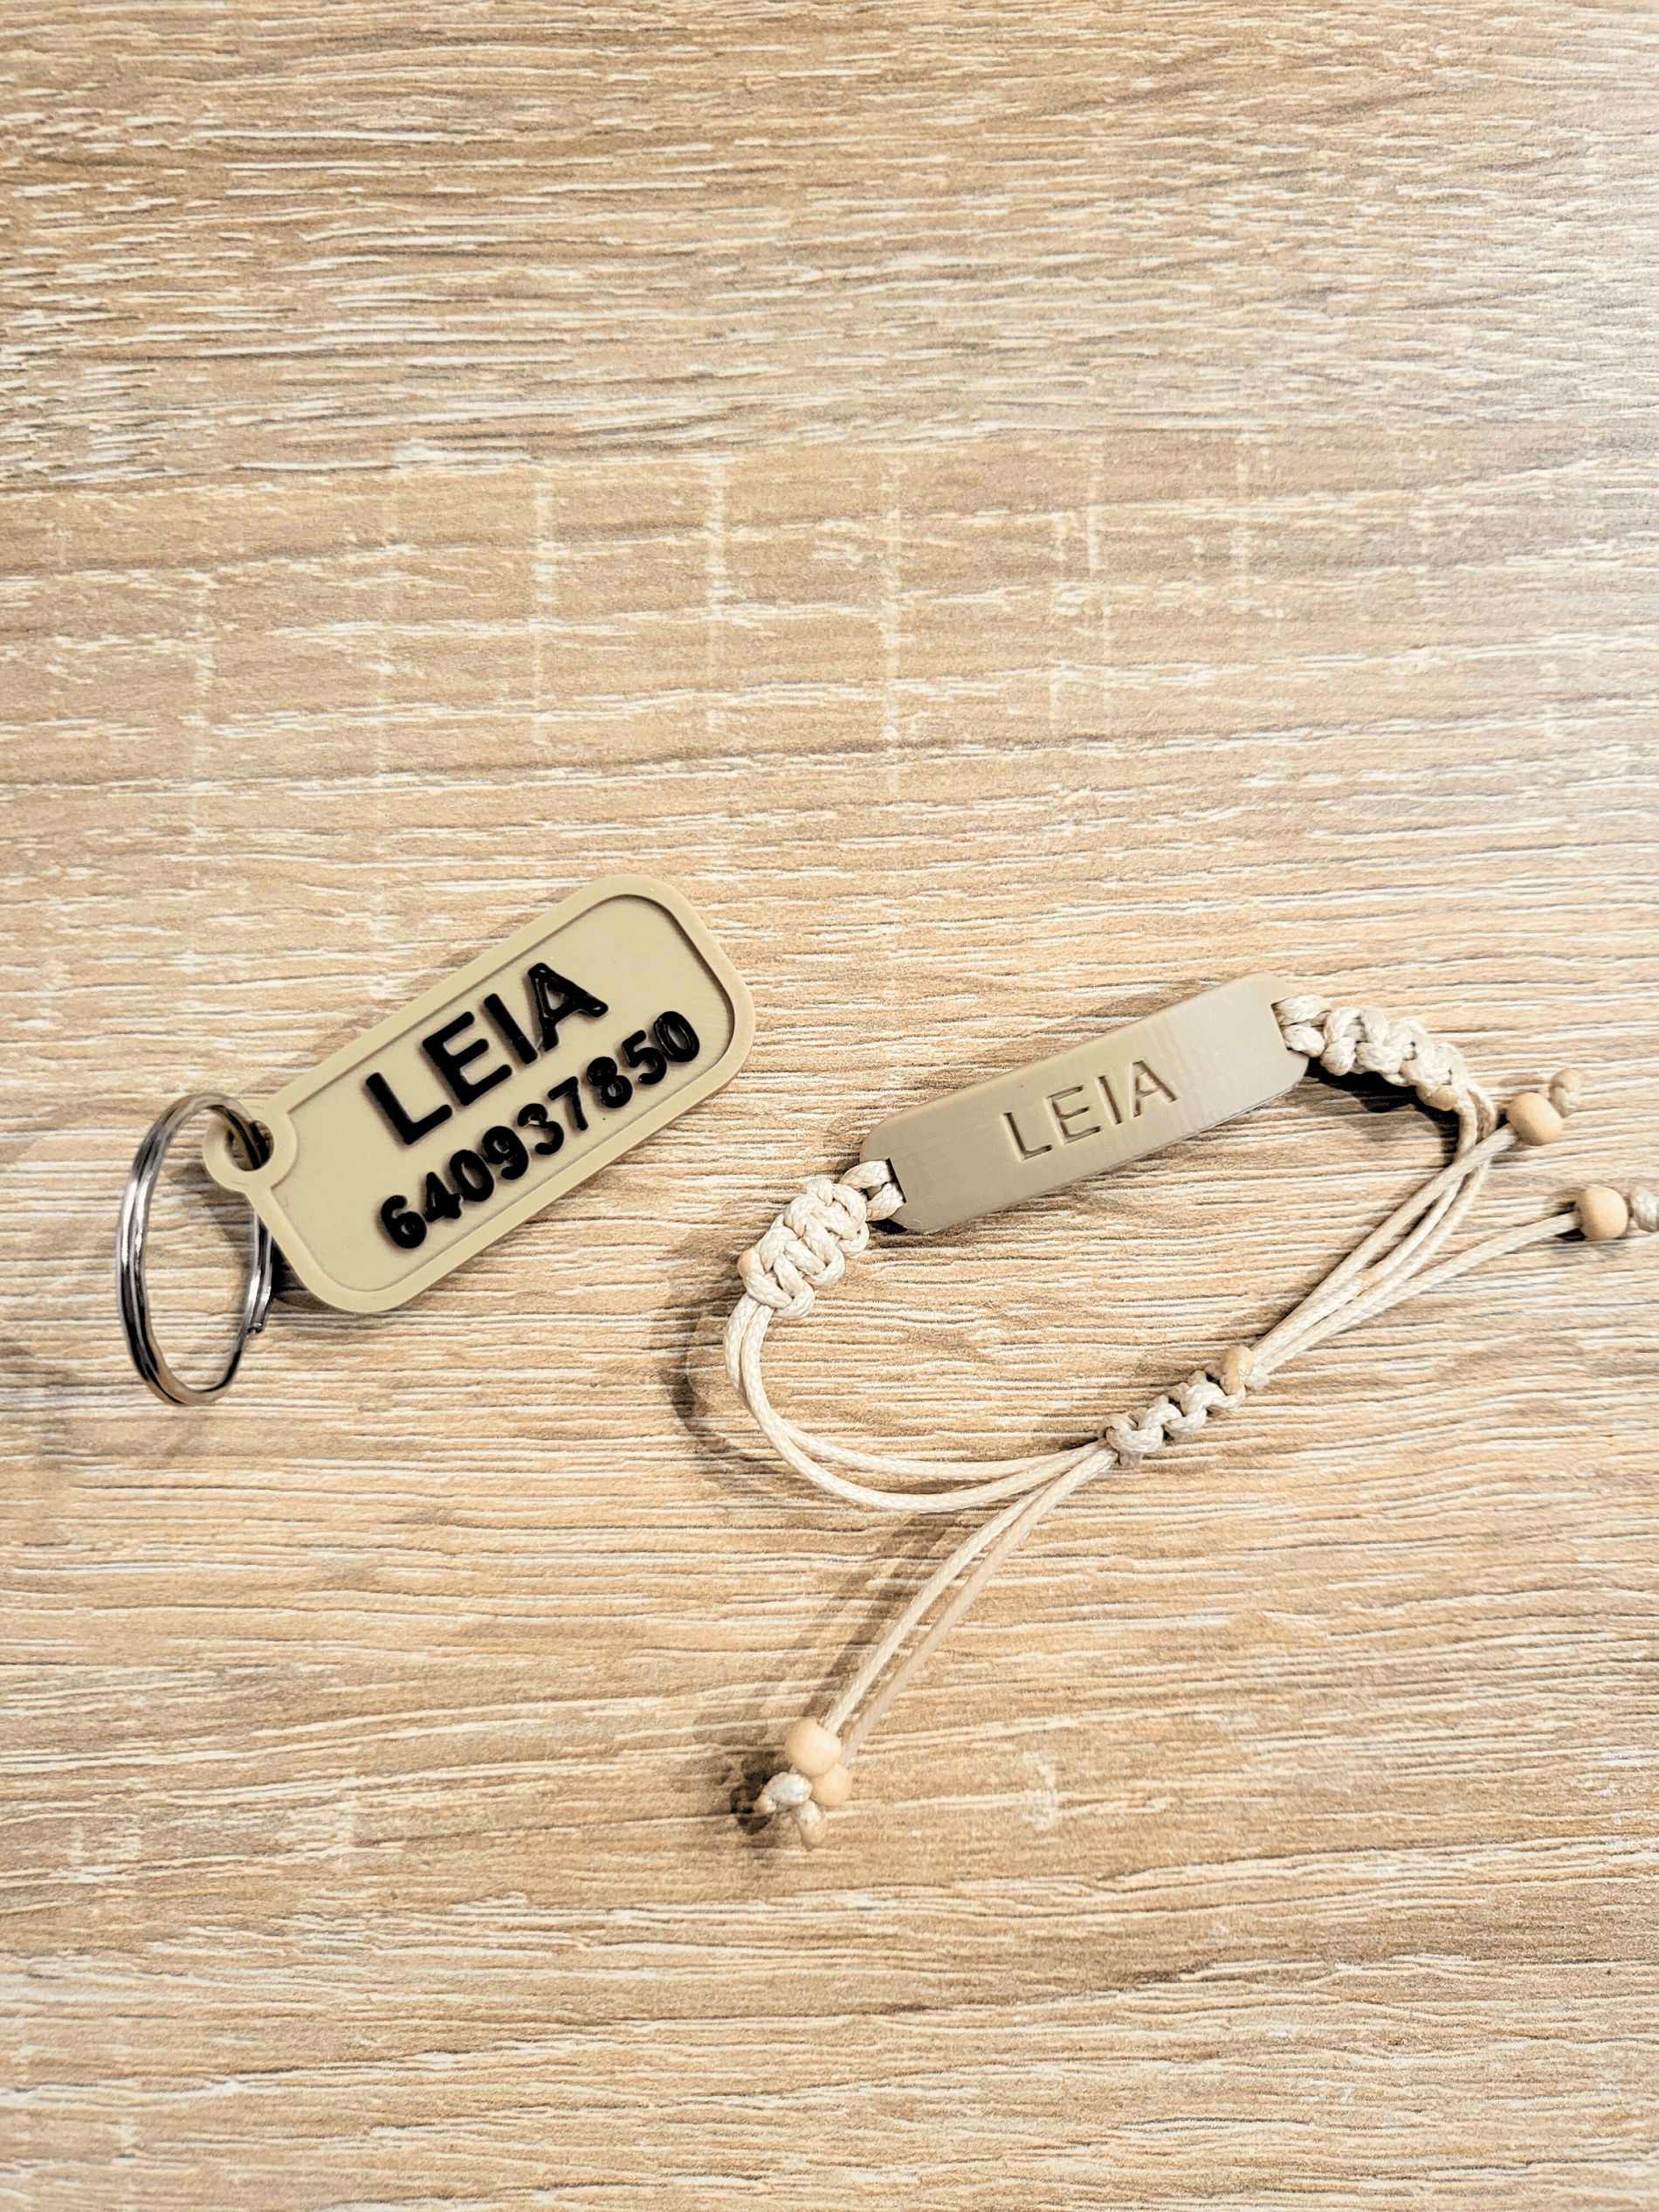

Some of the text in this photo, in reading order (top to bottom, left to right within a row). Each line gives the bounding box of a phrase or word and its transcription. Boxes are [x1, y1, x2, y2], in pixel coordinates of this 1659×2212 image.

[365, 962, 609, 1145] LEIA
[381, 1010, 699, 1249] 640937850
[1002, 1060, 1179, 1161] LEIA
